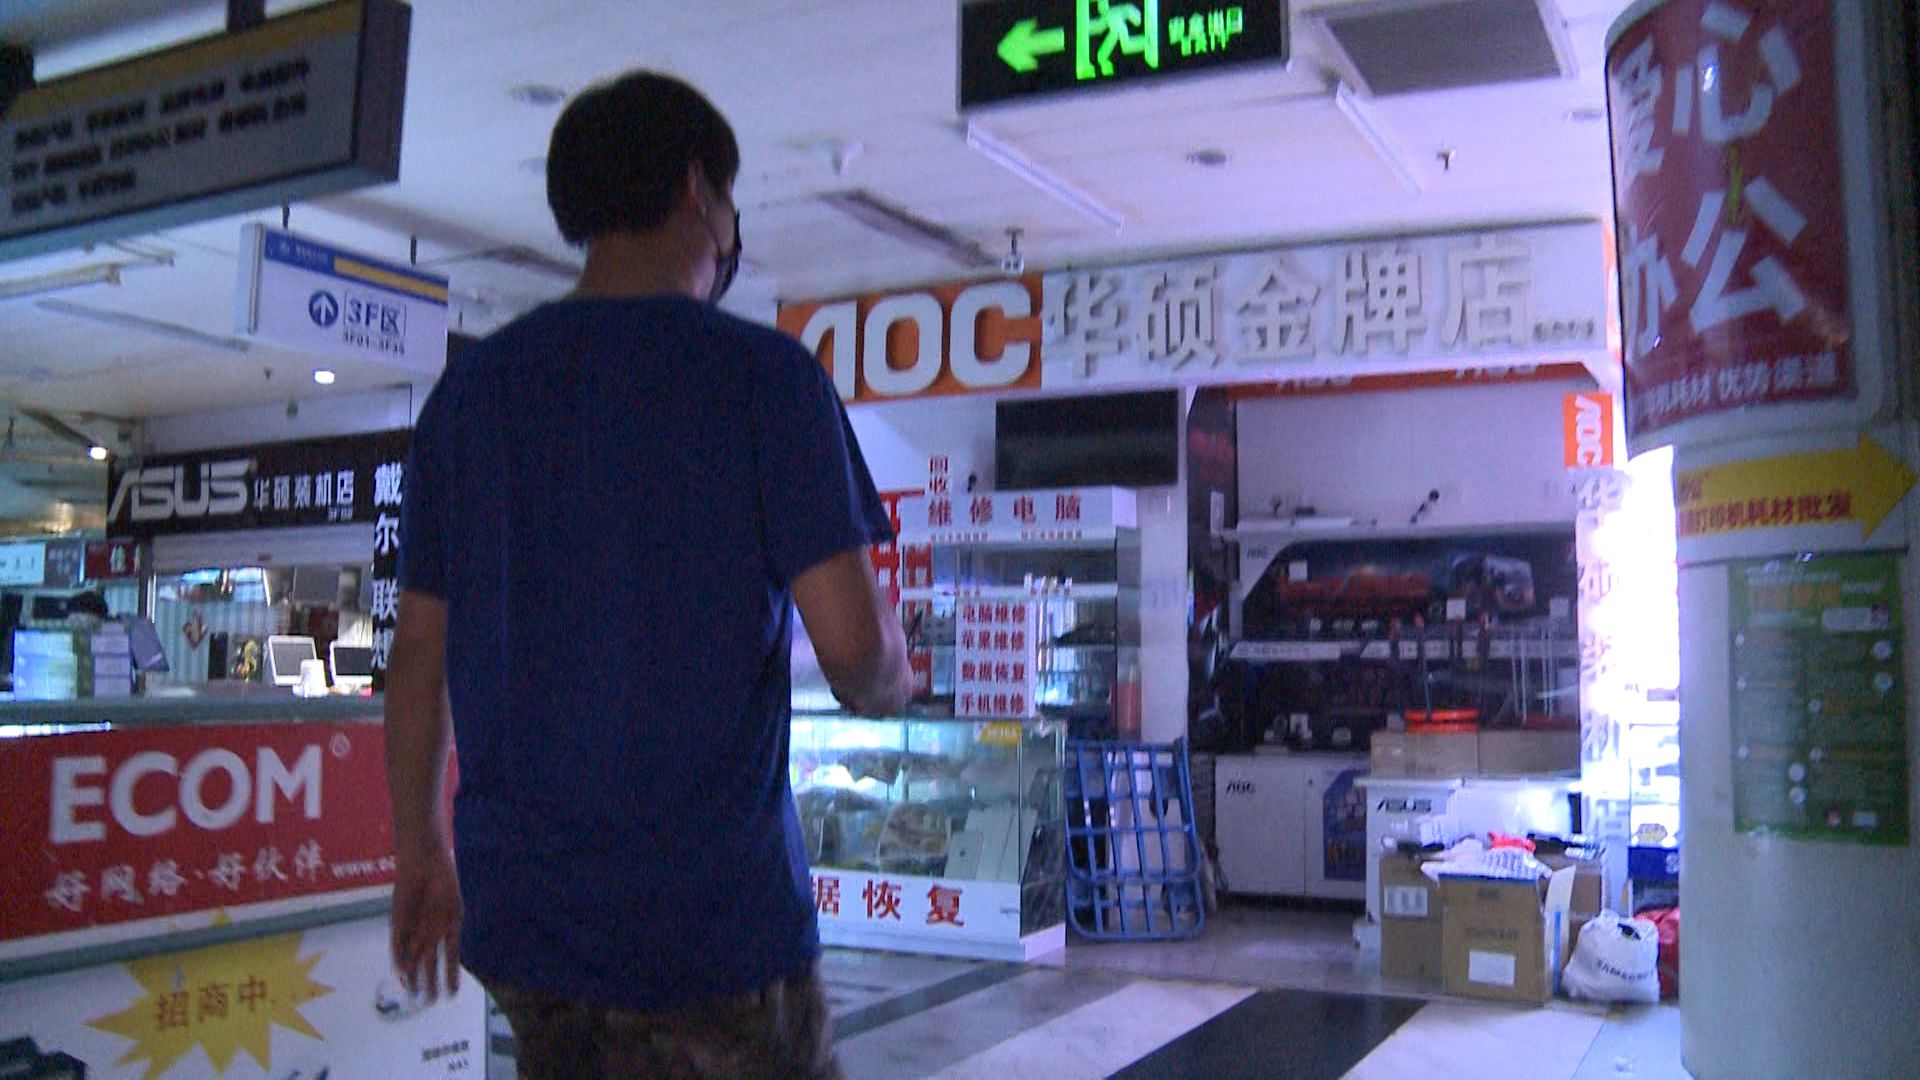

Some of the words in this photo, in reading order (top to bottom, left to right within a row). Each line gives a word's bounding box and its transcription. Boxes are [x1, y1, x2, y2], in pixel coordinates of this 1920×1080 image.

[1044, 230, 1531, 378] 华硕金牌店
[800, 279, 1033, 400] AOC
[1574, 395, 1603, 466] AOC
[107, 457, 259, 522] ASUS
[371, 461, 403, 555] 戴尔
[962, 630, 1025, 651] 苹果维修
[963, 602, 1025, 623] 电脑维修
[962, 661, 1025, 682] 数据恢复
[962, 693, 1024, 714] 手机维修
[50, 743, 324, 845] ECOM
[1376, 798, 1433, 814] ASUS
